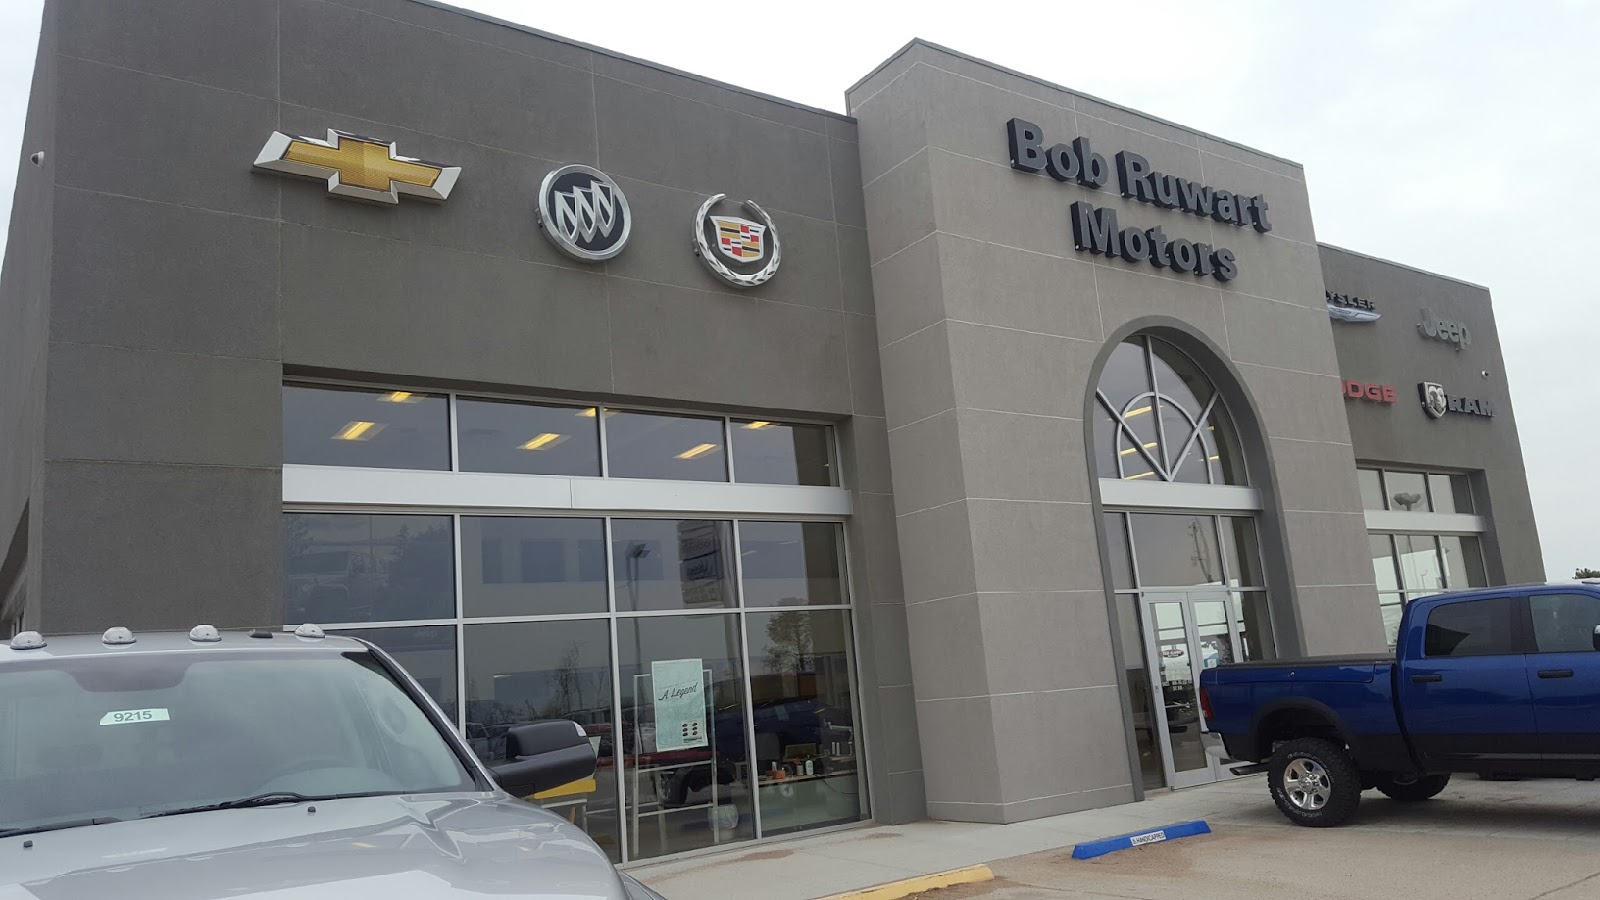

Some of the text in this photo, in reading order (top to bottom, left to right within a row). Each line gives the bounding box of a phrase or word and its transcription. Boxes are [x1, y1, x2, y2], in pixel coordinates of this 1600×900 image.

[1007, 118, 1272, 233] Bob Ruwart
[1070, 200, 1238, 282] Motors
[1416, 307, 1472, 350] Jeep
[1341, 379, 1398, 404] DGE
[1445, 394, 1495, 417] RAM
[113, 710, 152, 722] 9215
